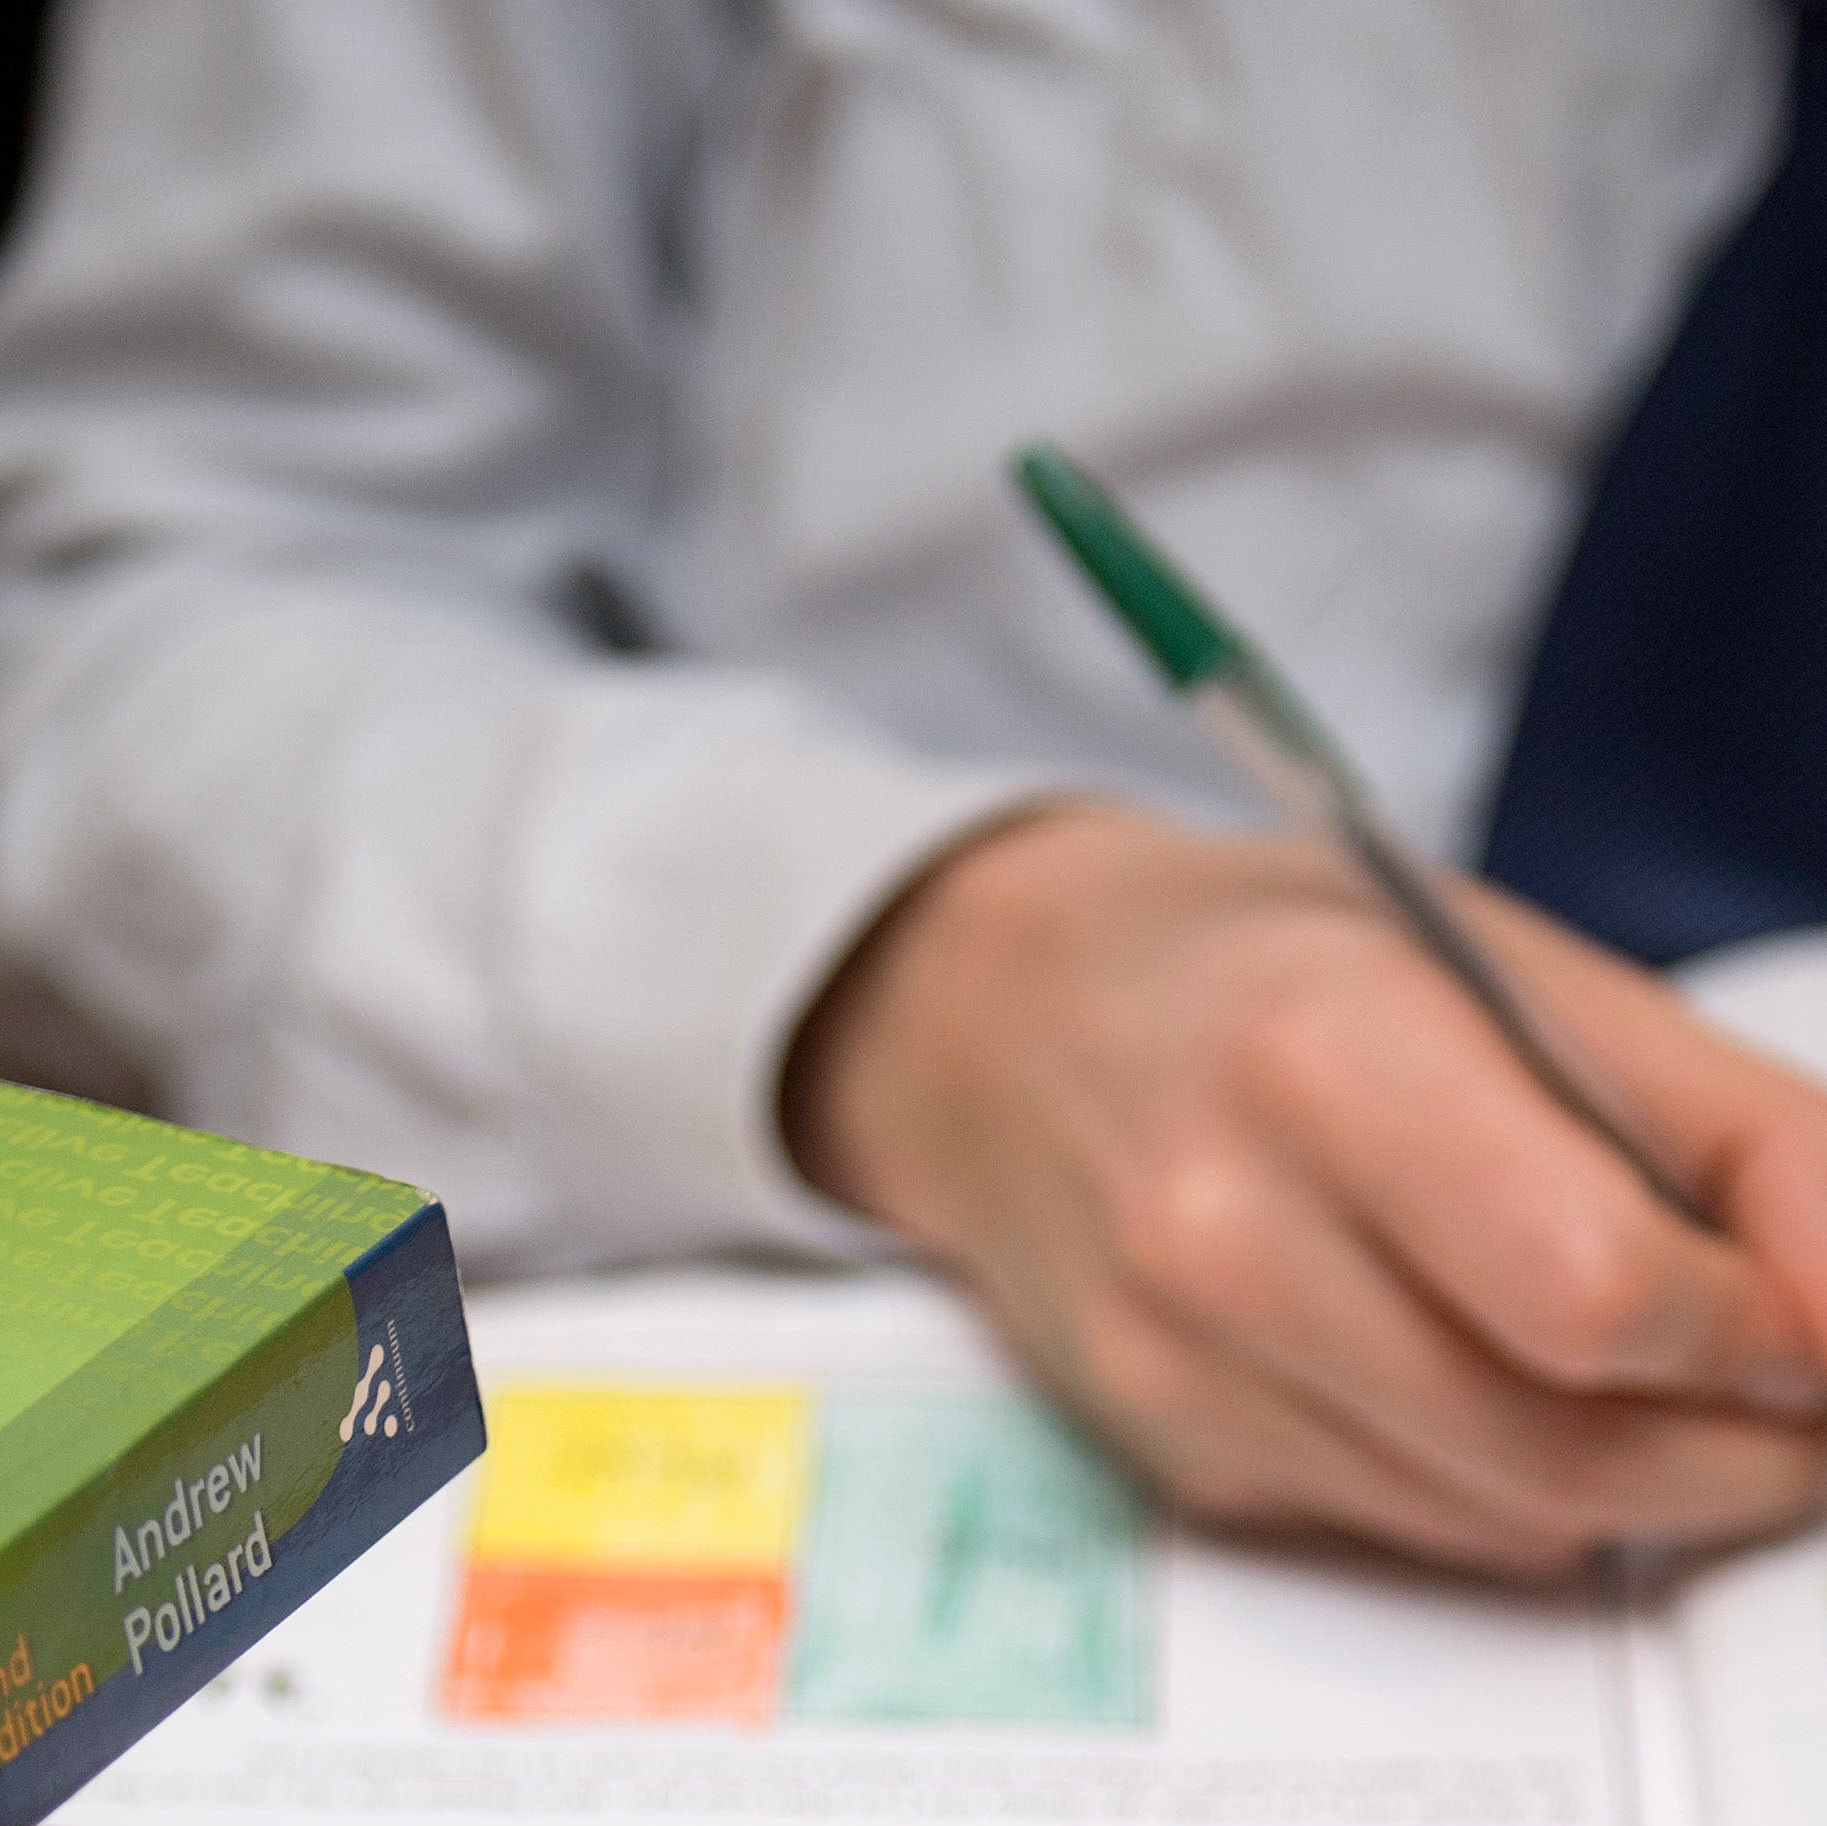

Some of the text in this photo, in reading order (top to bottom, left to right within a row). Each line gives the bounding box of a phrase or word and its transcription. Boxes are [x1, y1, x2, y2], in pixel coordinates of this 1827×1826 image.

[387, 1319, 415, 1432] continuum
[110, 1431, 266, 1595] Andrew
[123, 1520, 273, 1678] Pollard
